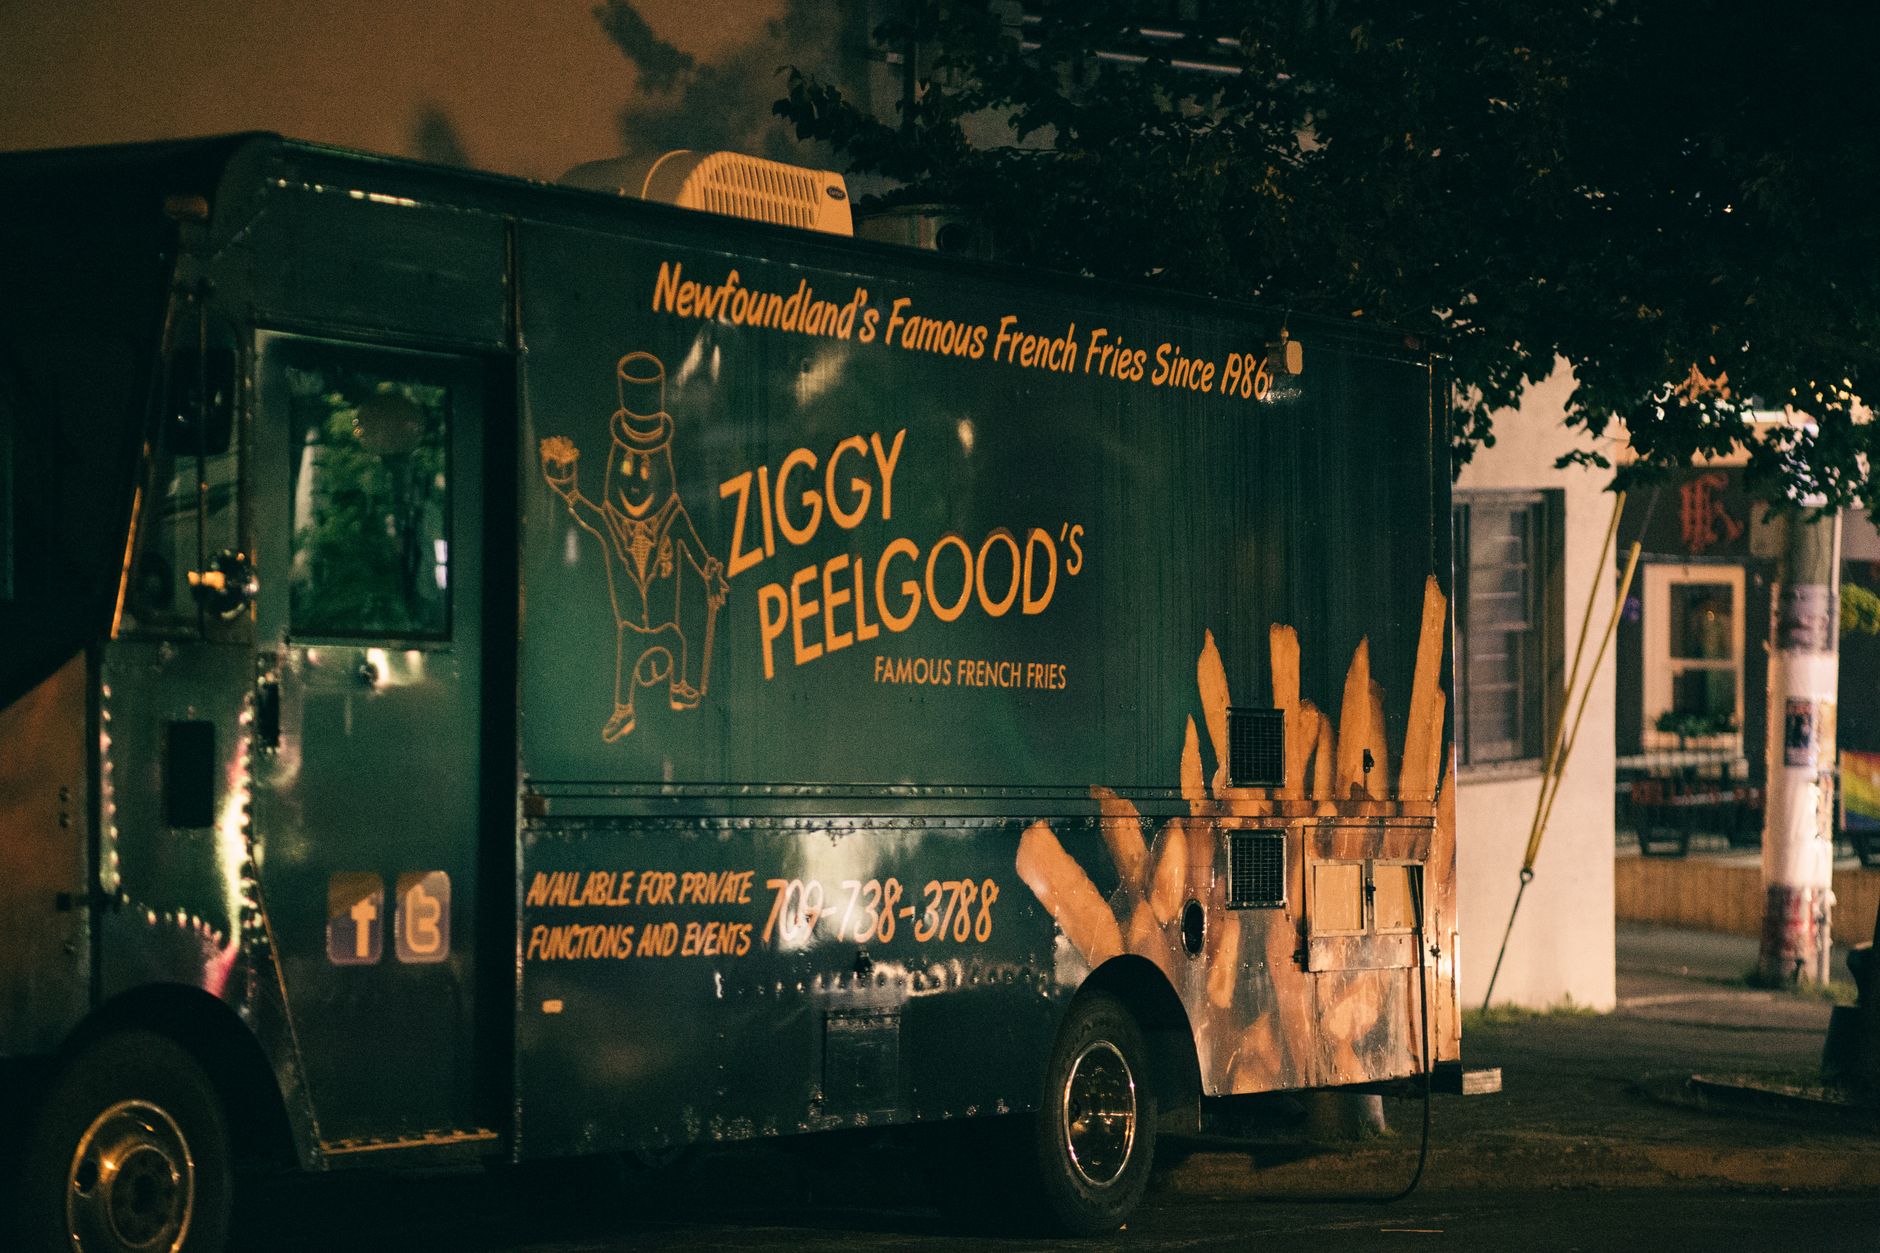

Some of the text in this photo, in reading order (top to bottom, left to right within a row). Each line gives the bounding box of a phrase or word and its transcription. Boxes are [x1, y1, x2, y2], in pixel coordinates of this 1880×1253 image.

[652, 262, 880, 344] Newfoundland's
[885, 297, 988, 359] Famous
[993, 315, 1078, 373] French
[1084, 328, 1148, 383] Fries
[1151, 342, 1215, 393] Since
[719, 428, 907, 578] ZIGGY
[757, 522, 1085, 680] PEELGOOD'S
[873, 655, 1067, 689] FAMOUS FRENCH FRIES
[526, 870, 754, 907] AVAILABLE FOR PRIVATE
[762, 877, 1000, 944] 709-738-3788
[526, 921, 753, 961] FUNCTIONS AND EVENTS
